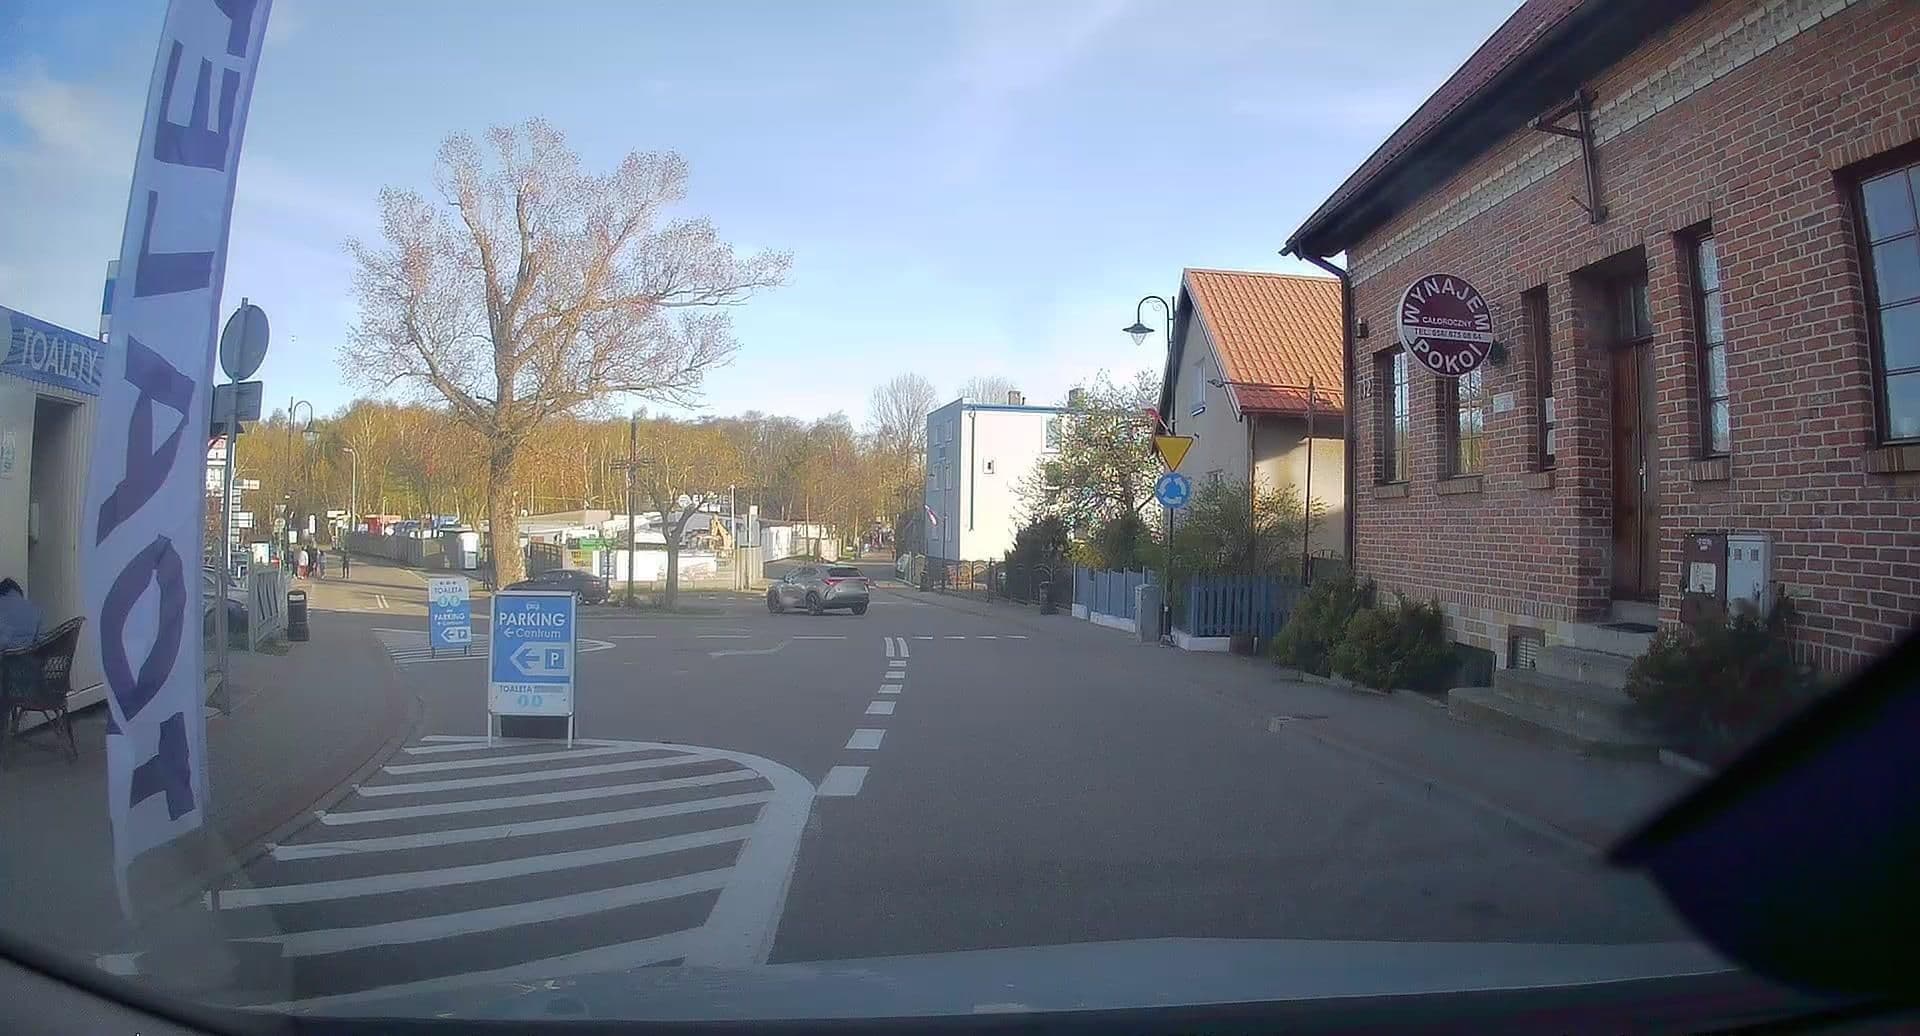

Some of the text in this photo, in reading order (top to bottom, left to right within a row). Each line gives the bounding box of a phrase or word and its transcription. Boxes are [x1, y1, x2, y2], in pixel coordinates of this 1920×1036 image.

[1404, 278, 1490, 330] WYNAJEM
[22, 327, 99, 384] TOALETY
[1413, 339, 1482, 373] POKOI
[434, 612, 466, 621] PARKING
[499, 612, 566, 627] PARKING
[516, 628, 561, 639] Centrum
[551, 652, 560, 666] P
[500, 685, 533, 694] TOALETA
